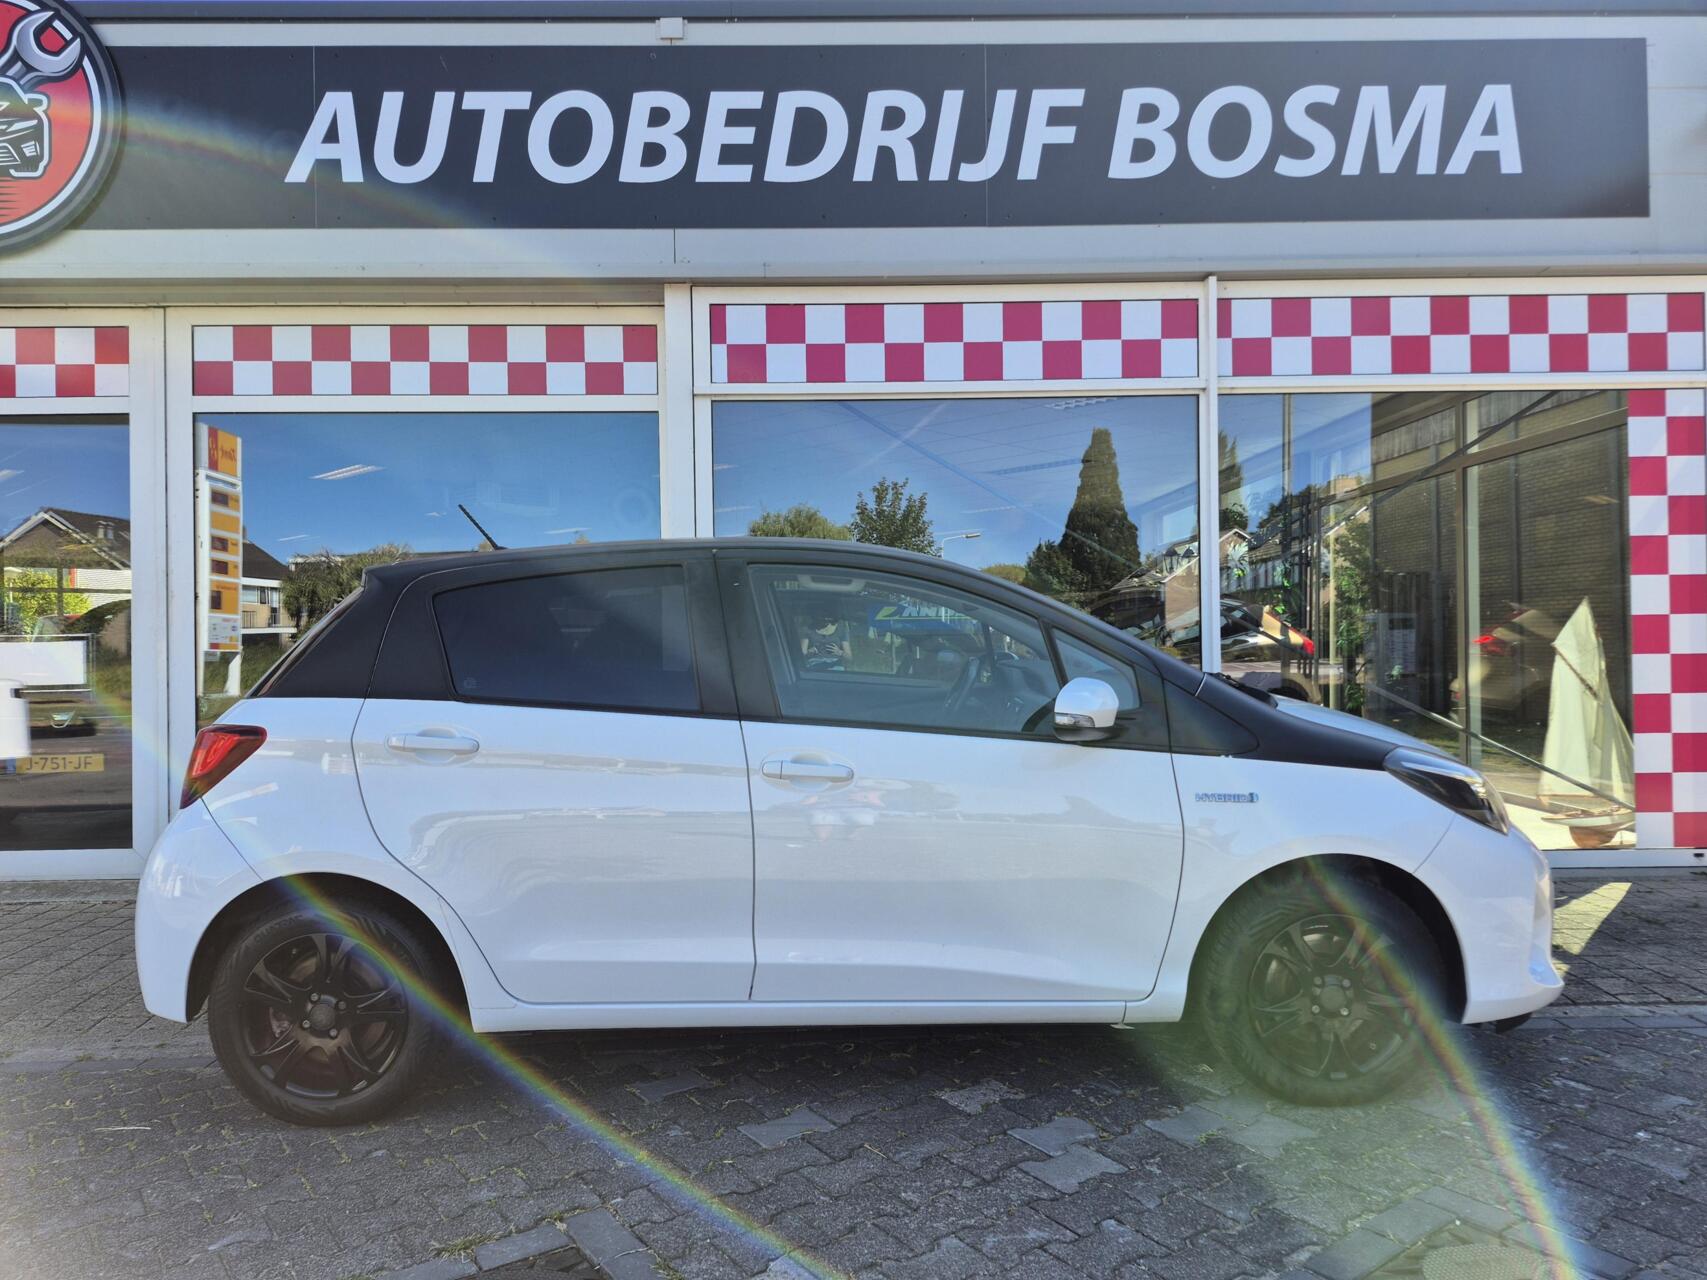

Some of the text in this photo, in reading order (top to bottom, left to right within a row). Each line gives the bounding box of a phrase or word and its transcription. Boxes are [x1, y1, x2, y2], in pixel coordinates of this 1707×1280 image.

[285, 84, 1523, 184] AUTOBEDRIJF BOSMA
[26, 756, 92, 771] J-751-JF
